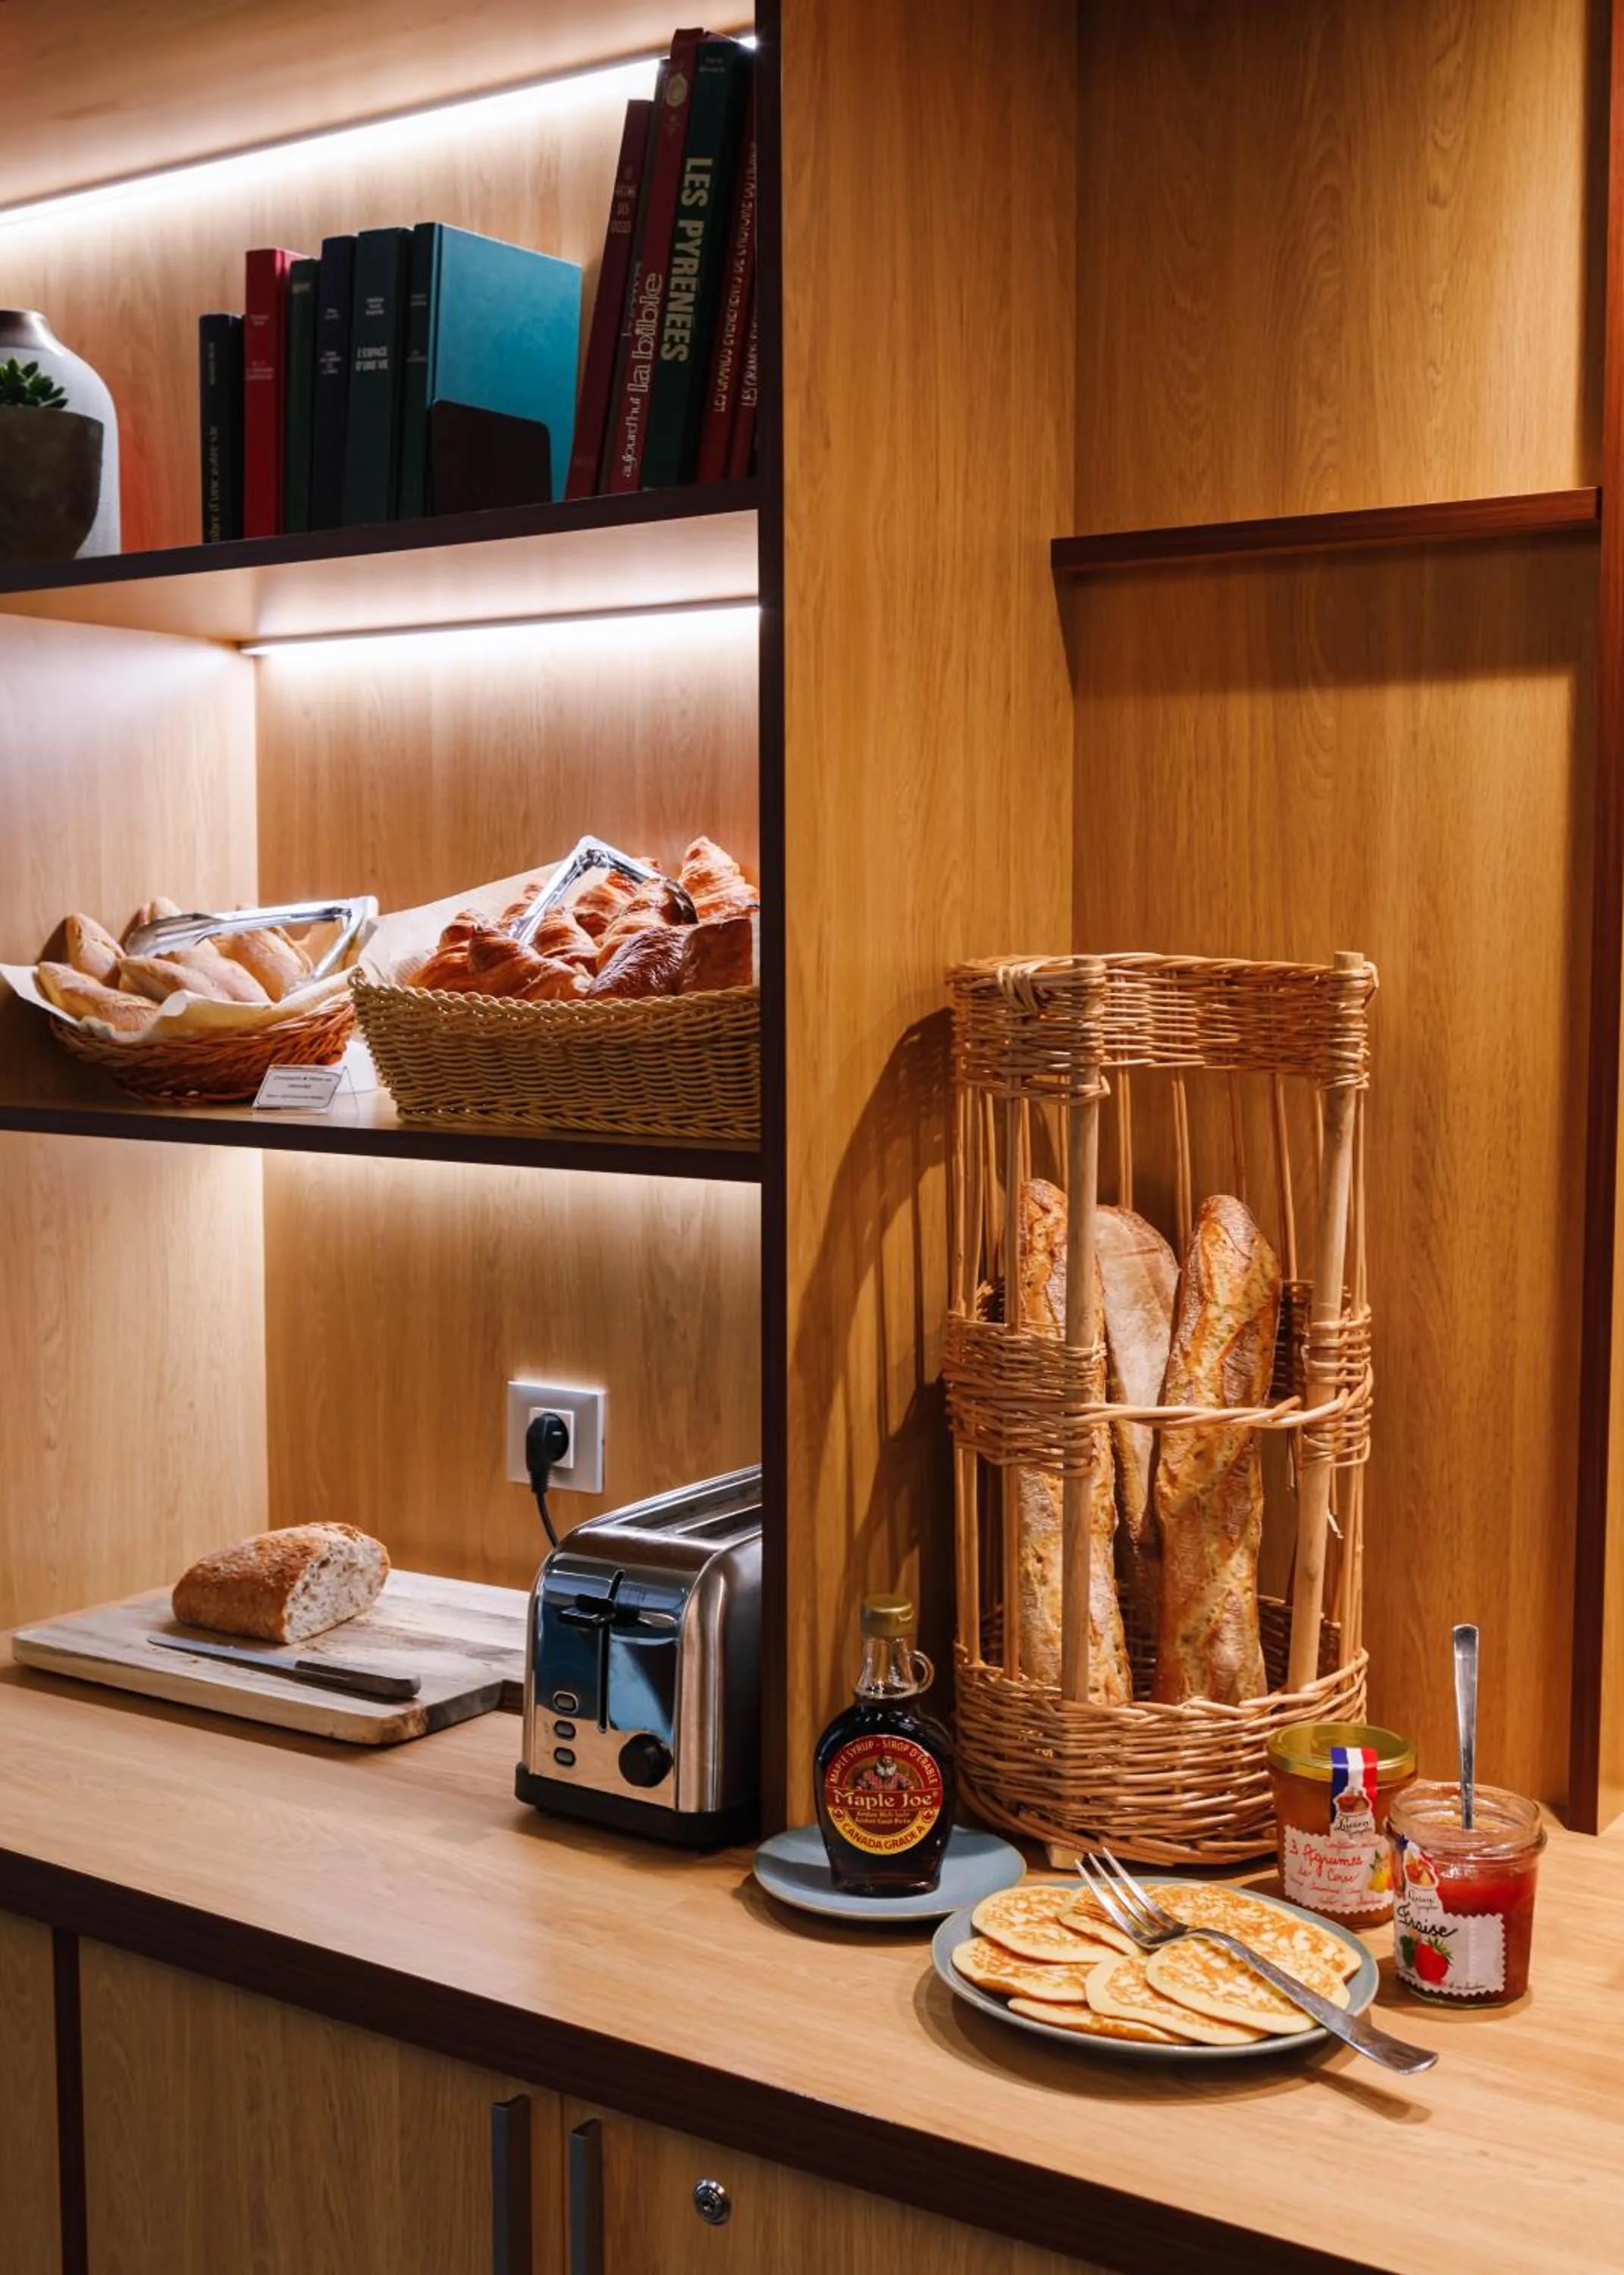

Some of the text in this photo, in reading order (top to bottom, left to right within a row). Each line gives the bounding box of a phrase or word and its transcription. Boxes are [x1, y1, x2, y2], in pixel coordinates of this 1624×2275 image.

[682, 158, 713, 207] LES
[632, 272, 663, 359] bible
[628, 363, 651, 393] la
[829, 1754, 849, 1784] MAPLE
[848, 1740, 874, 1758] SYRUP
[882, 1740, 911, 1752] SIROP
[832, 1789, 932, 1810] Maple Joe
[842, 1822, 883, 1849] CANADA
[884, 1831, 917, 1850] GRADE
[1301, 1844, 1363, 1878] Agrumes
[1397, 1902, 1459, 1938] Fraise
